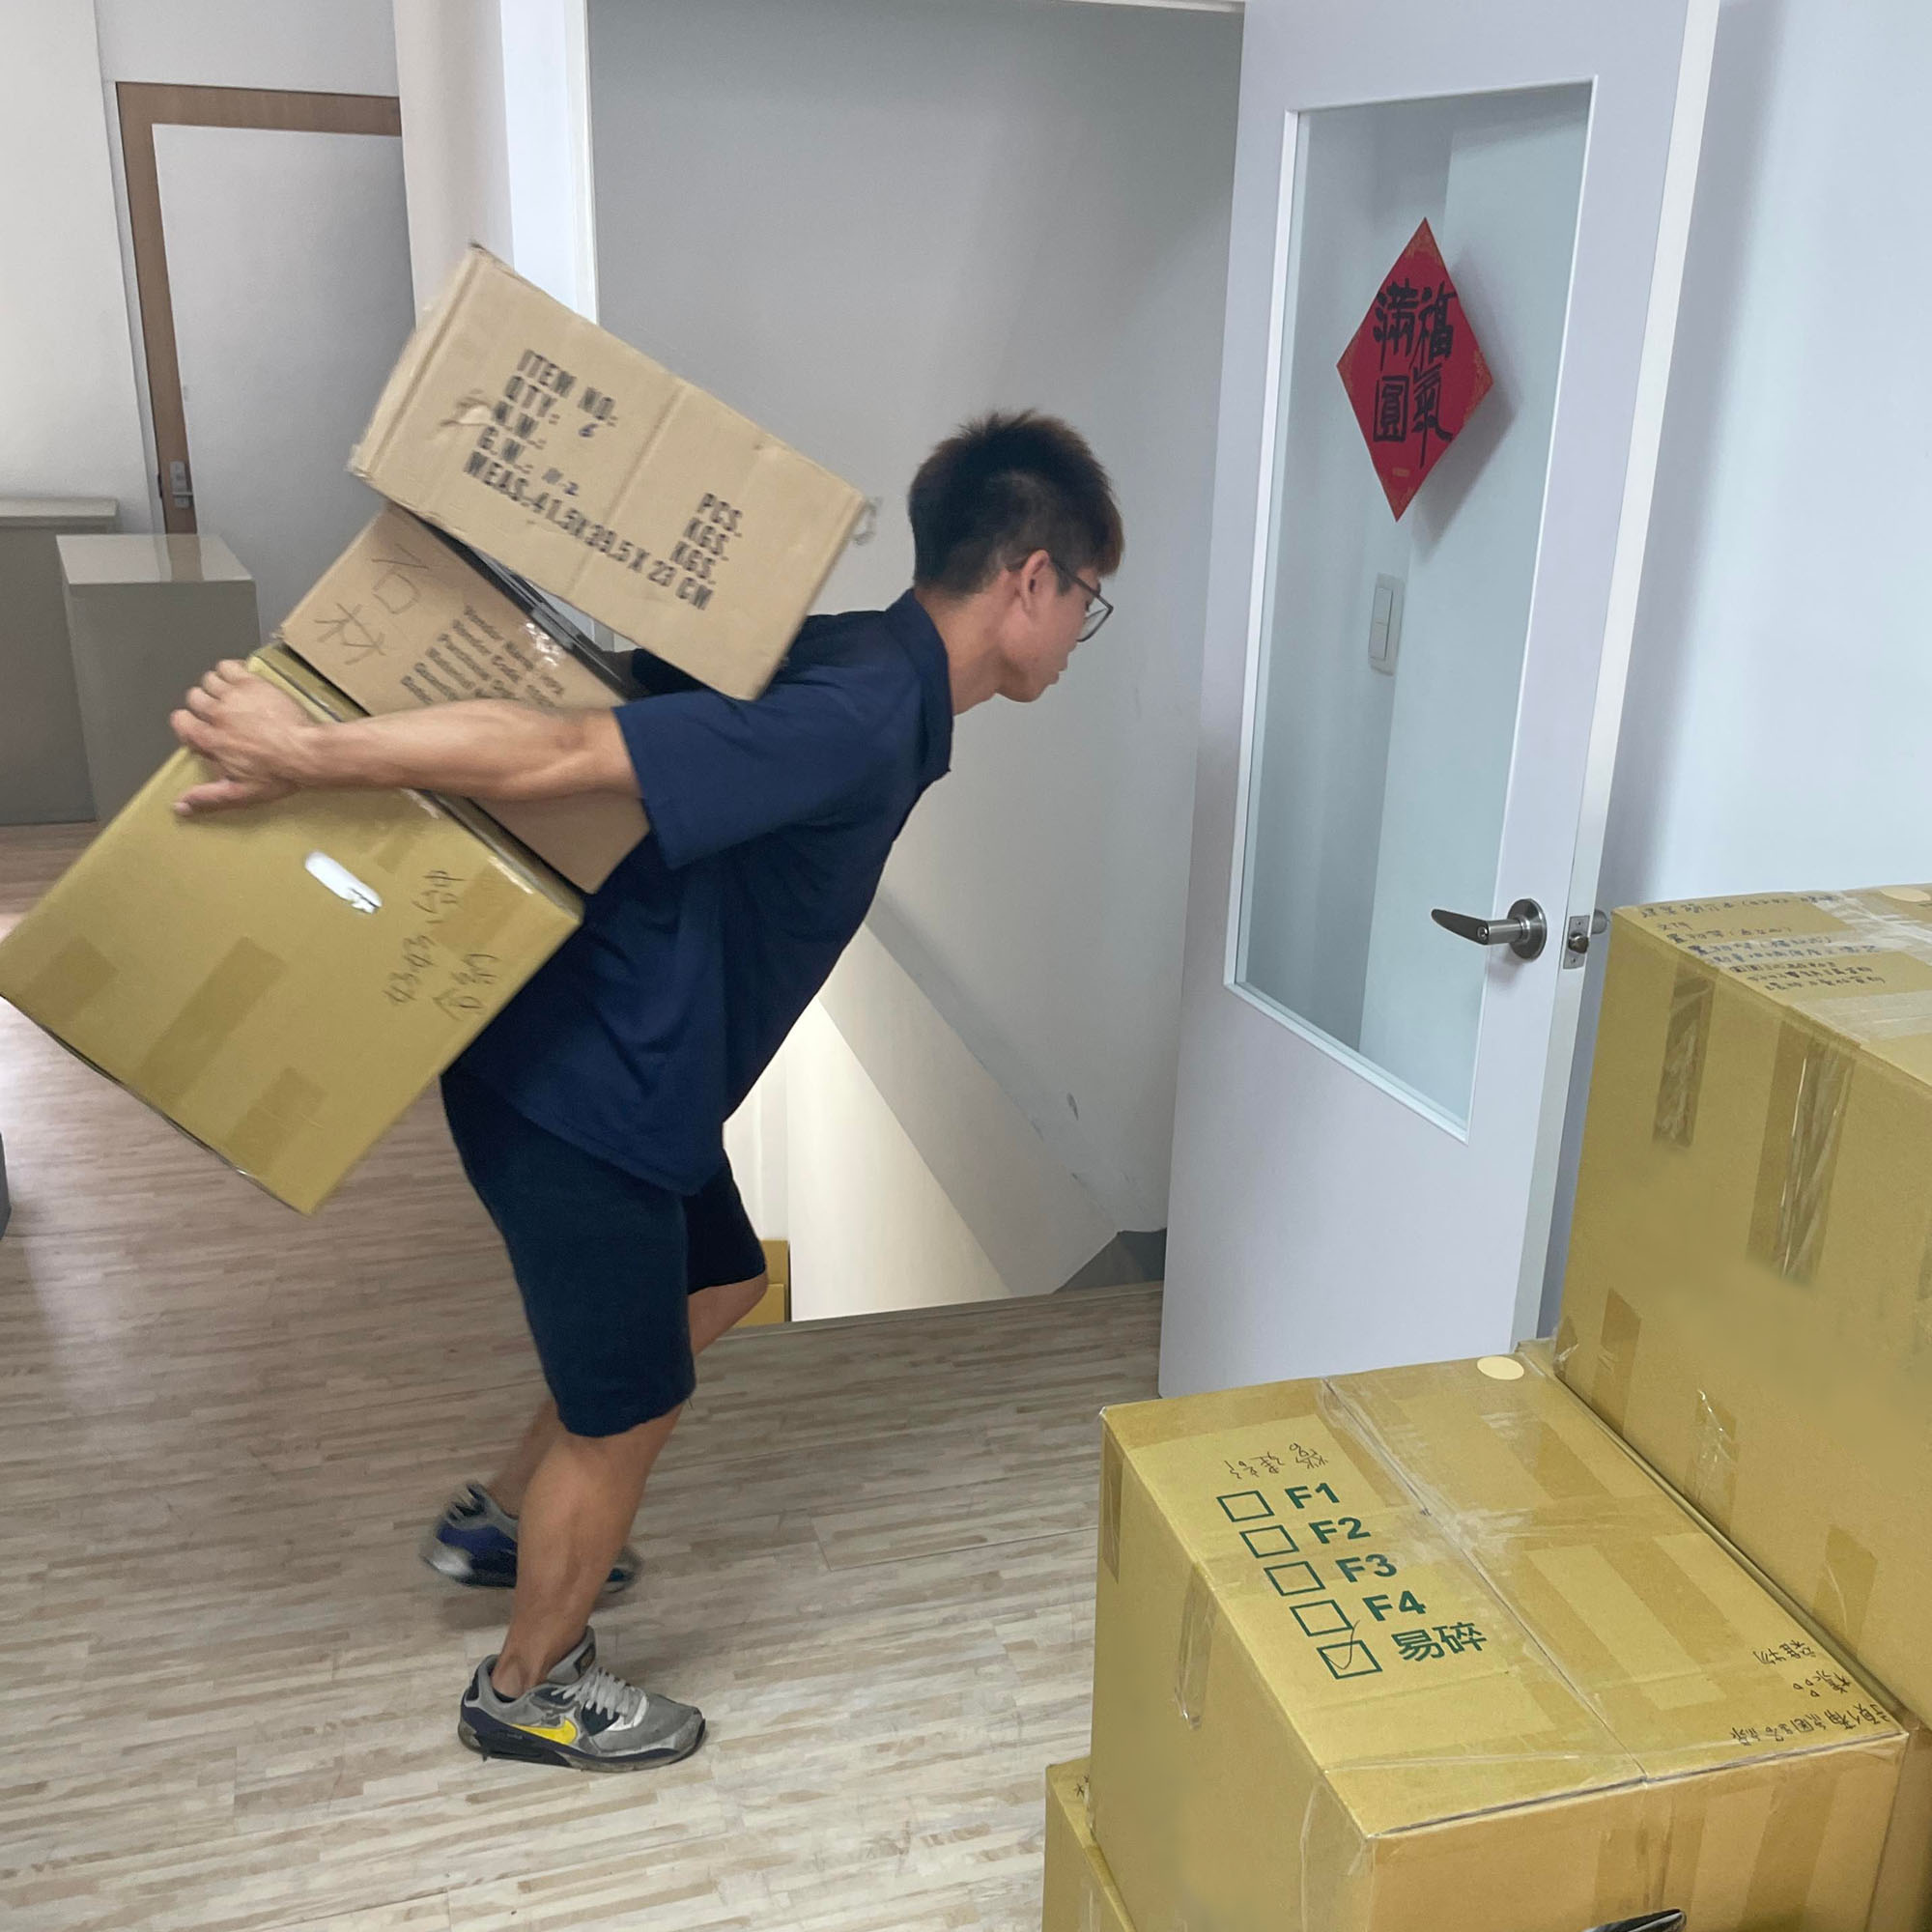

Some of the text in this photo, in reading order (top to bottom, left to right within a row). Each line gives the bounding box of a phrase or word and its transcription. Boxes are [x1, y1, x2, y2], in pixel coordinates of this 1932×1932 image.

[697, 493, 743, 538] PCS.
[675, 579, 715, 611] CM
[1284, 1482, 1341, 1509] F1
[1308, 1517, 1372, 1544] F2
[1335, 1553, 1398, 1583] F3
[1361, 1590, 1427, 1622] F4
[1391, 1621, 1488, 1662] 易碎
